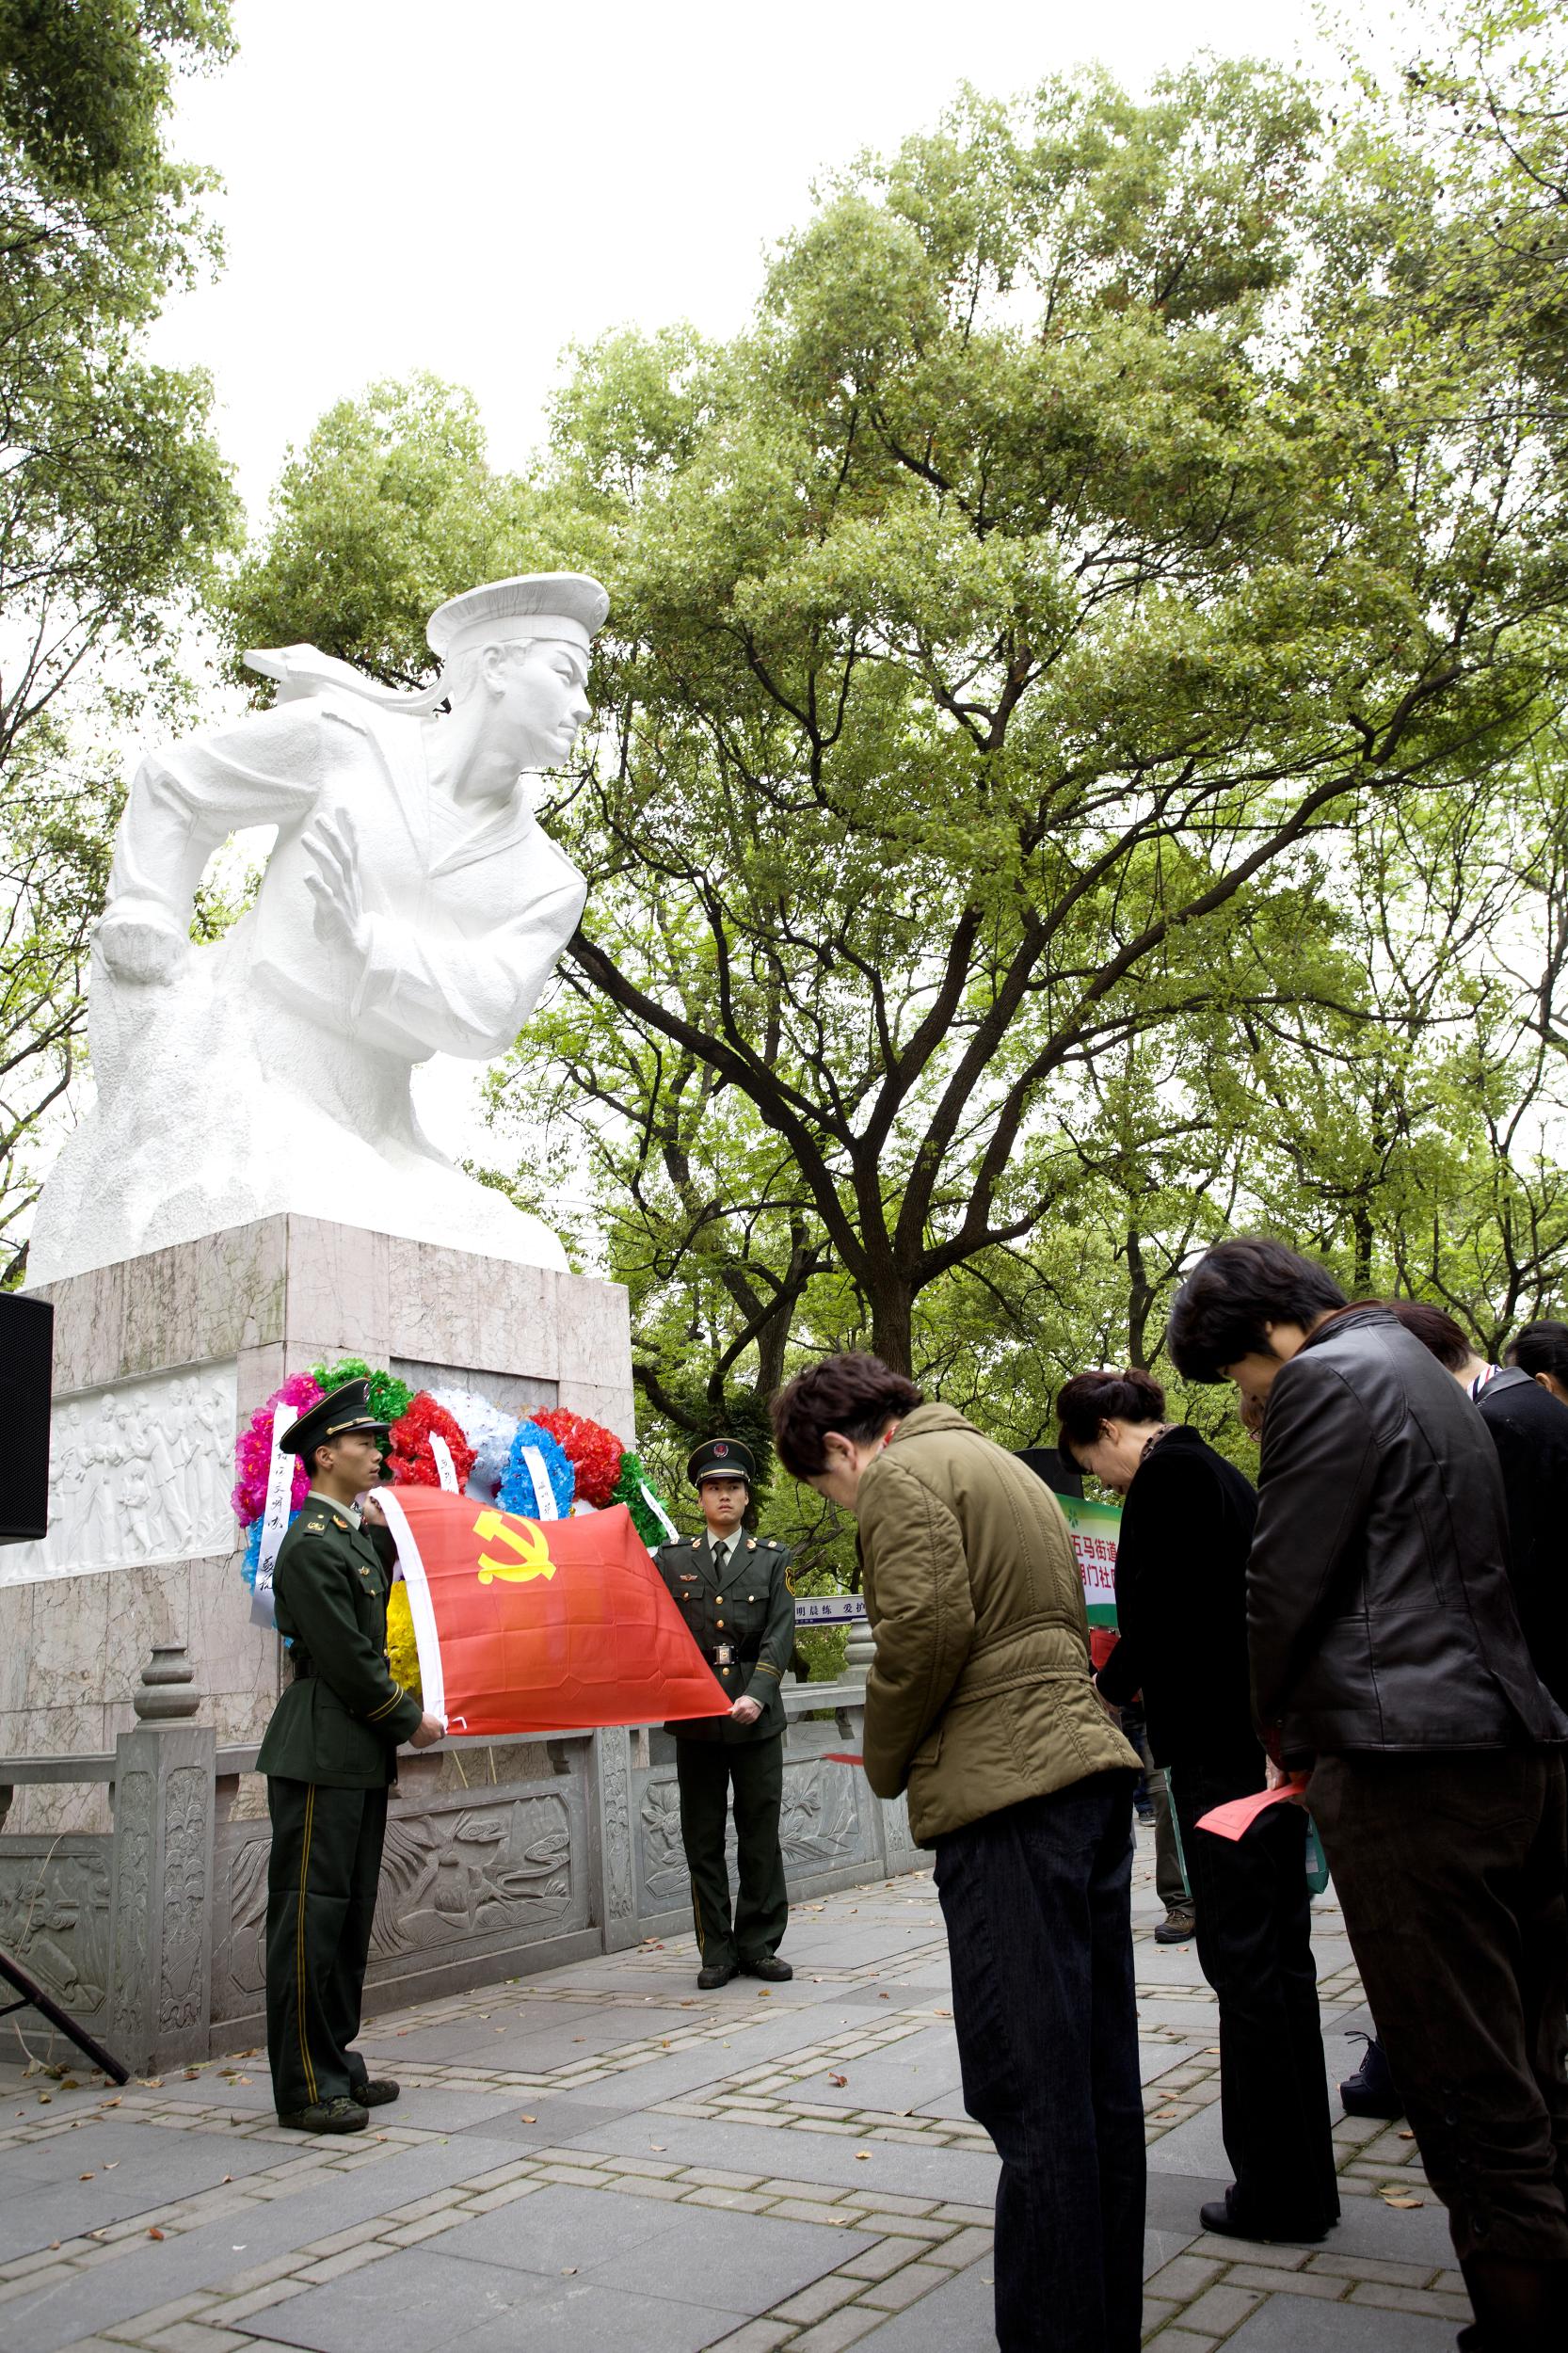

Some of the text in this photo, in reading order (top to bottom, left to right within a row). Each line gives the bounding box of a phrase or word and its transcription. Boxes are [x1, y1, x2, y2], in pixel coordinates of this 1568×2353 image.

[1070, 1534, 1118, 1562] 五马街道
[796, 1605, 832, 1616] 明晨练
